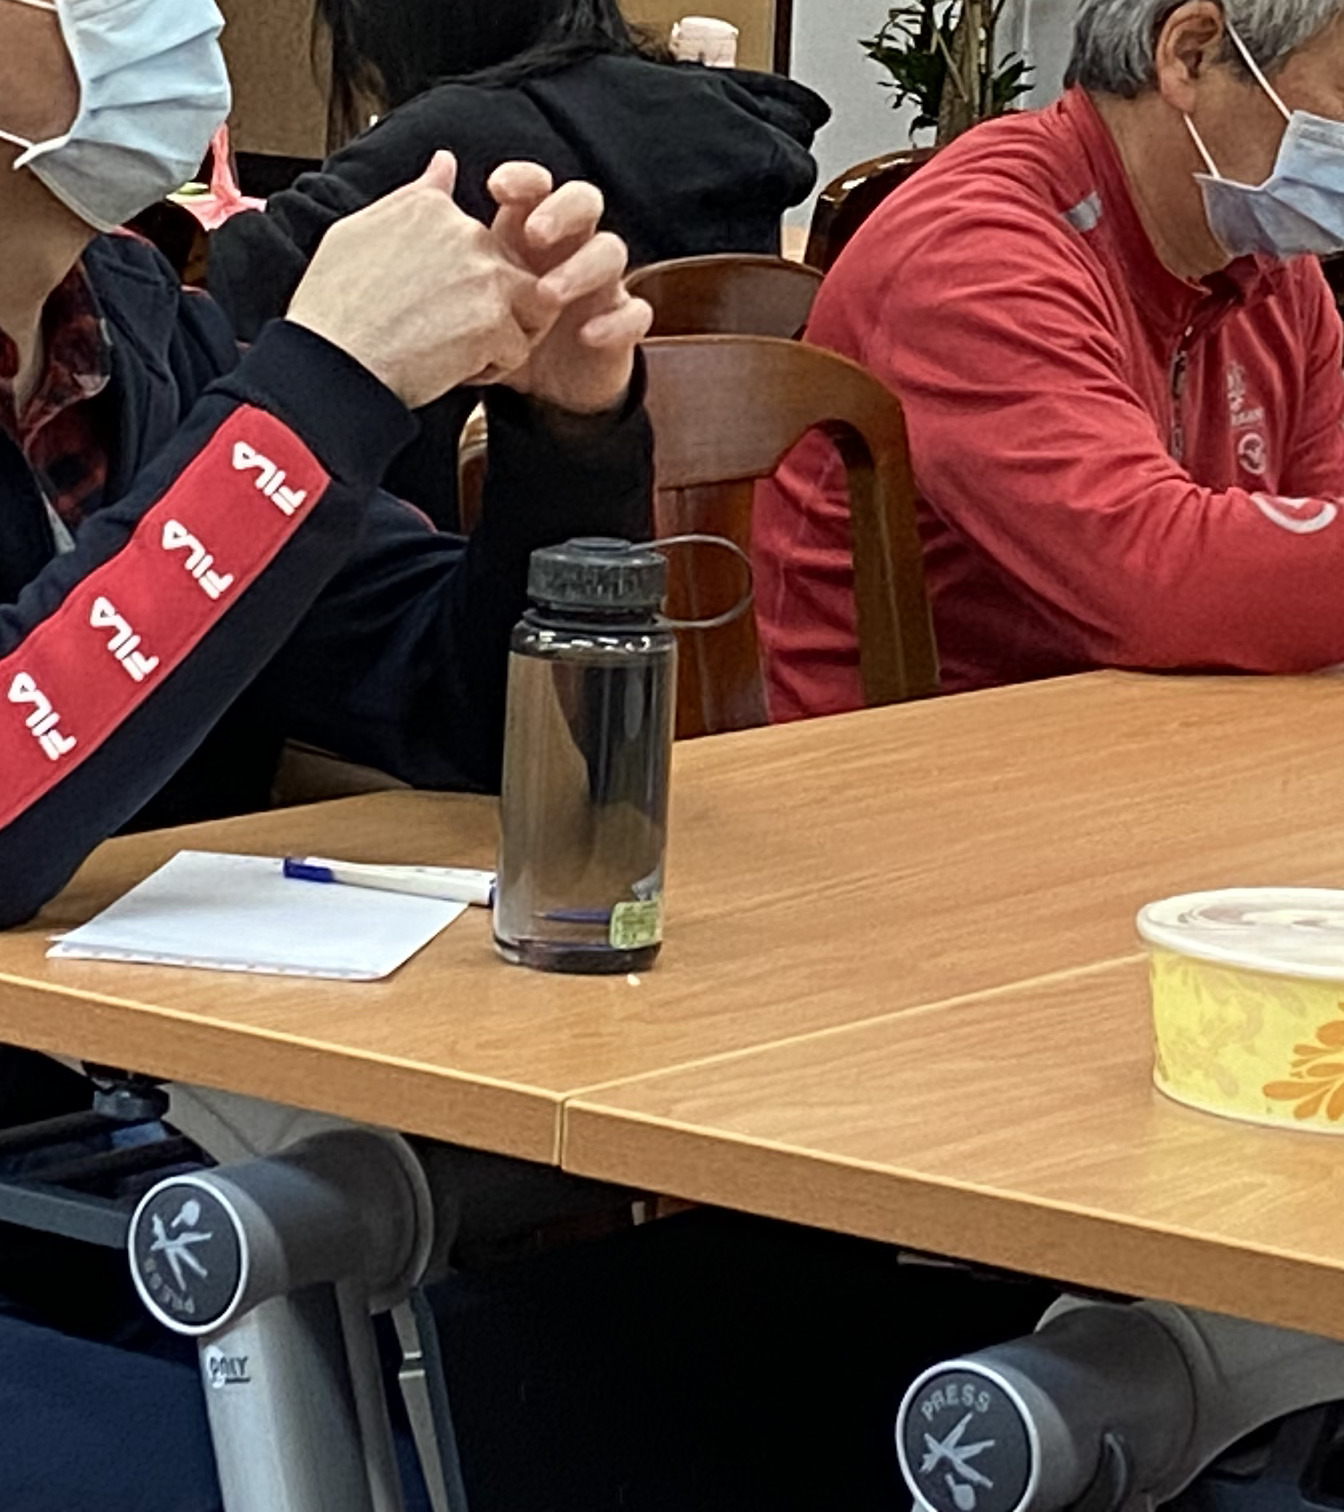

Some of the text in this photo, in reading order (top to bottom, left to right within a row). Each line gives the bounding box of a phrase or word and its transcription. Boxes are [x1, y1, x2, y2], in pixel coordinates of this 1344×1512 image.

[232, 440, 308, 517] FILA
[162, 519, 234, 600] FILA
[90, 596, 160, 682] FILA
[7, 671, 77, 762] FILA
[920, 1383, 992, 1422] PRESS
